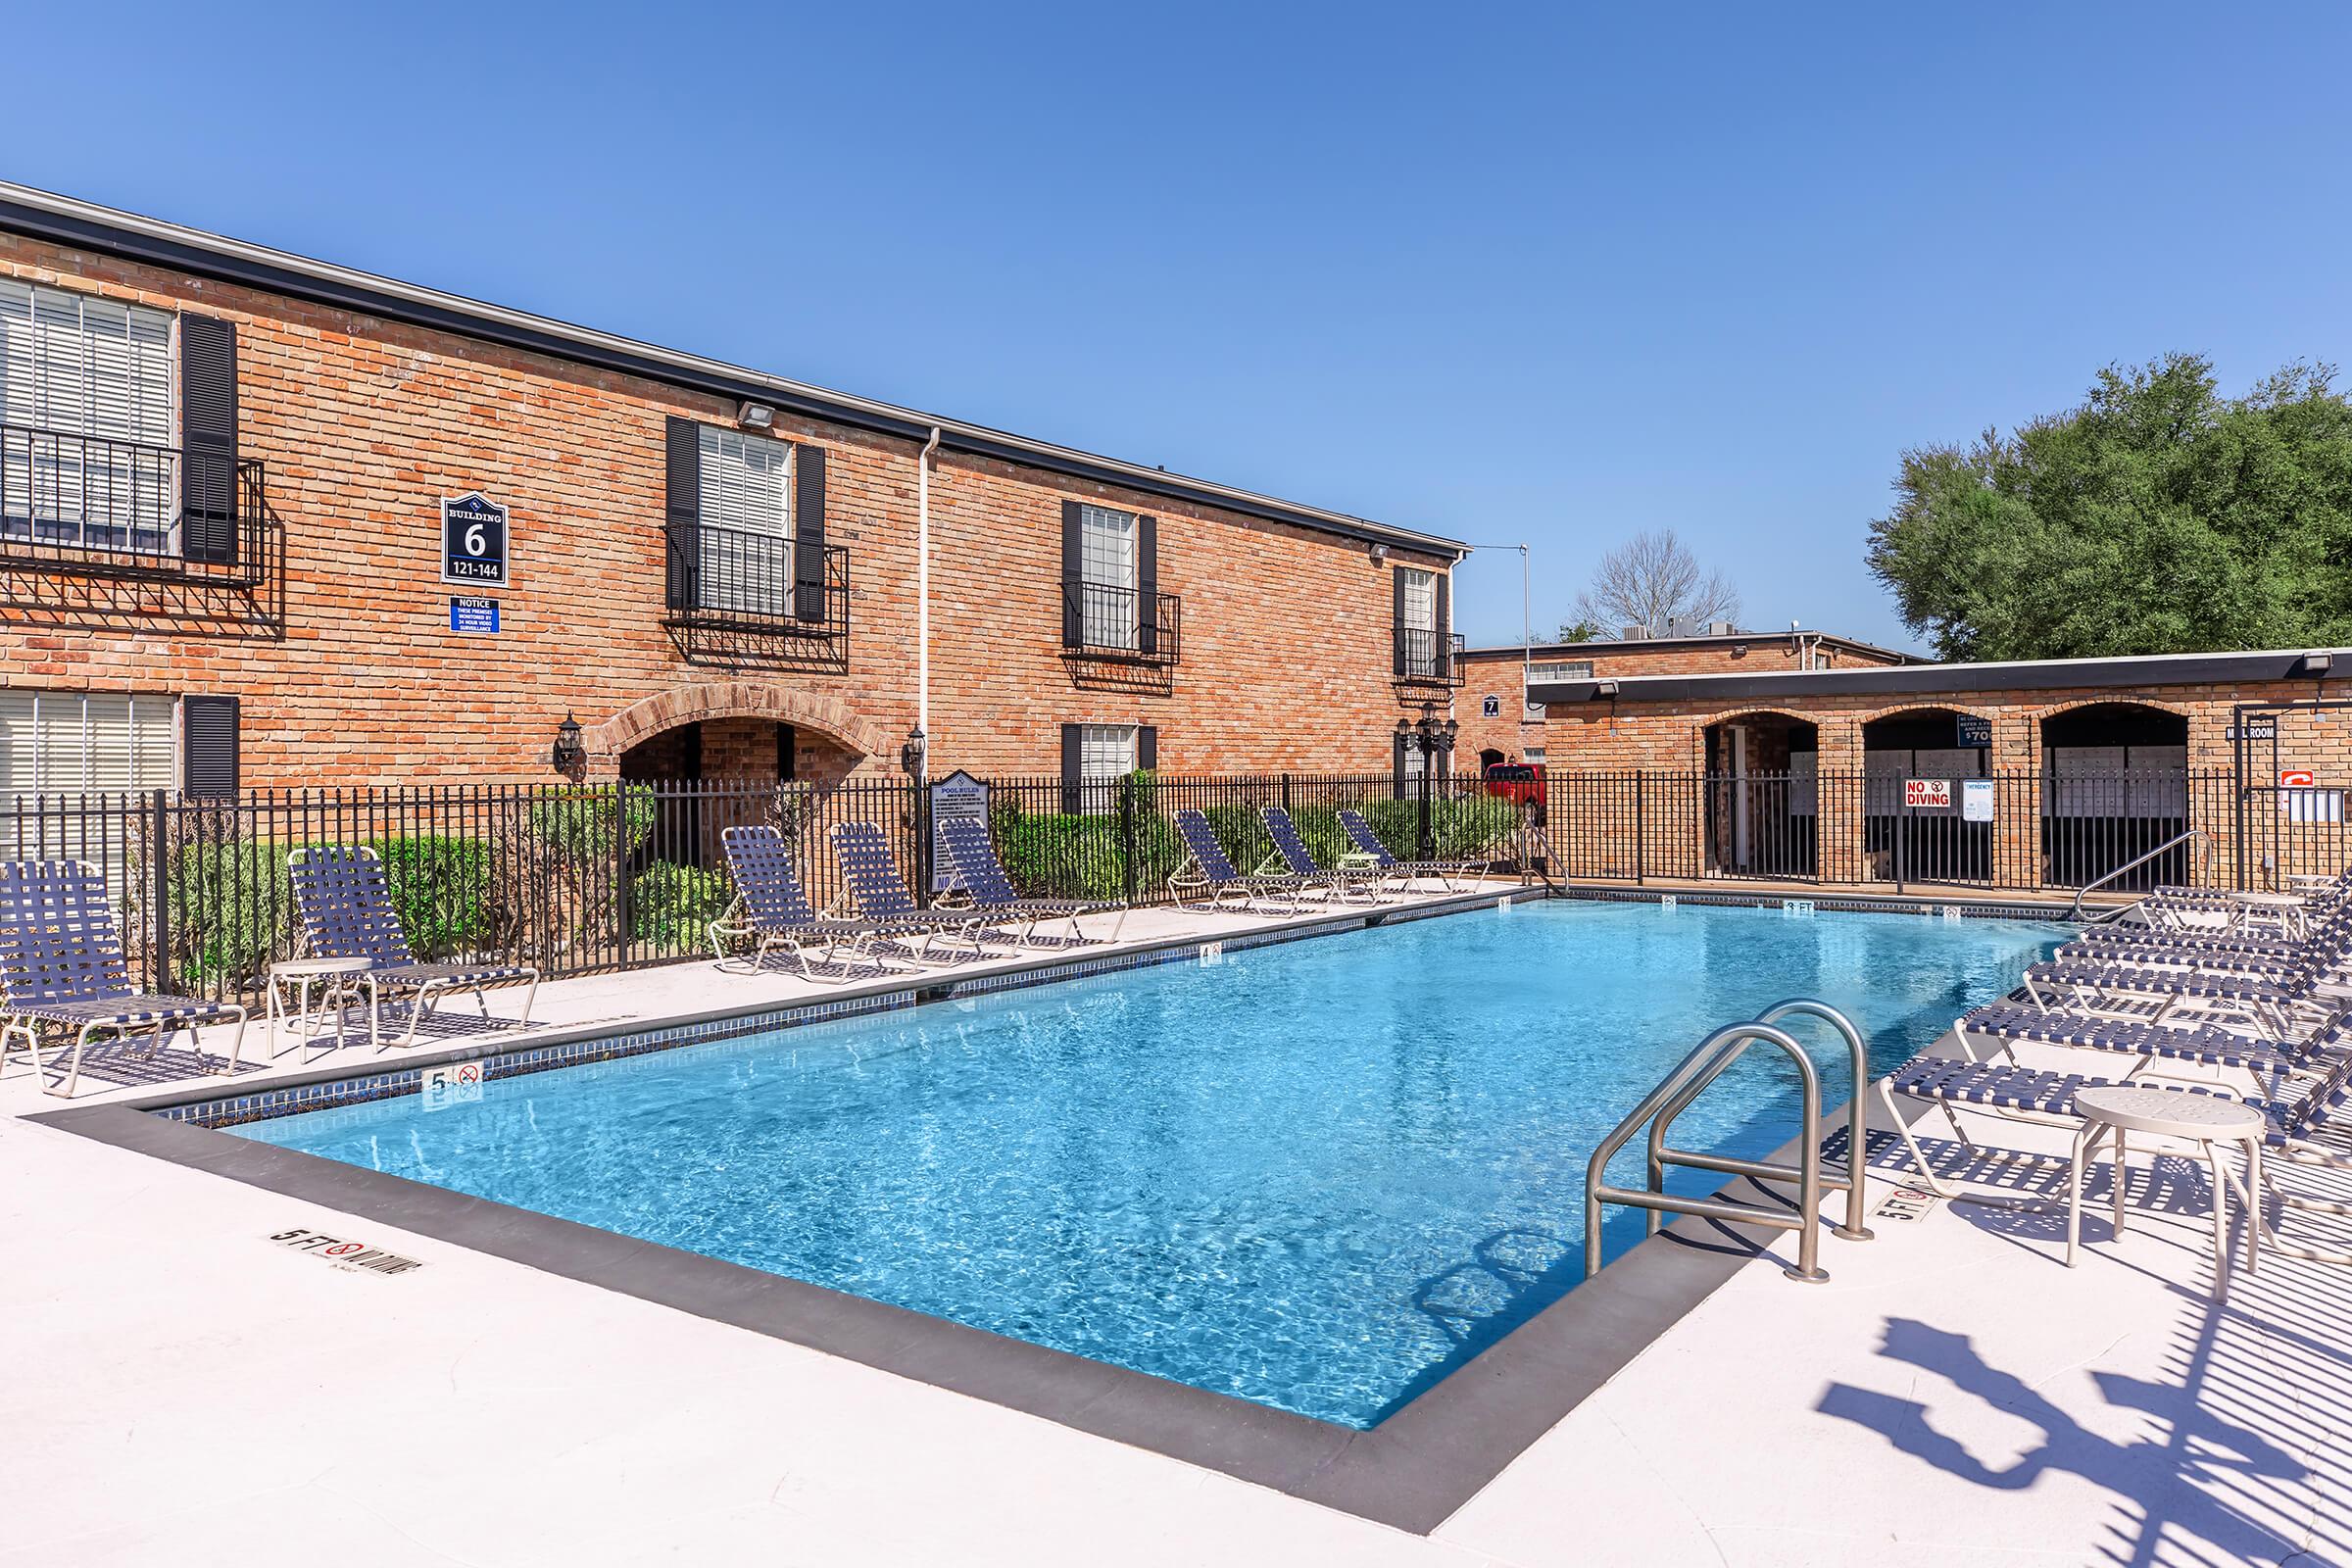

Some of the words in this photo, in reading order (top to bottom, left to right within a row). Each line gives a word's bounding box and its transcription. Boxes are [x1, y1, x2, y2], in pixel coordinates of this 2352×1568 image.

[448, 509, 503, 523] BUILDING
[465, 523, 486, 557] 6
[453, 561, 499, 578] 121-144
[460, 599, 490, 609] NOTICE
[1488, 702, 1495, 711] 7
[1965, 731, 1991, 741] $70
[2227, 727, 2248, 738] ML
[2250, 727, 2274, 738] ROOM
[1907, 781, 1925, 793] NO
[1907, 794, 1949, 805] DIVING
[1799, 903, 1812, 911] FT
[1202, 947, 1208, 957] 4
[432, 1071, 447, 1091] 5
[1884, 1199, 1925, 1213] FT
[1876, 1210, 1914, 1220] 5
[270, 1229, 311, 1241] 5
[288, 1235, 341, 1250] FT
